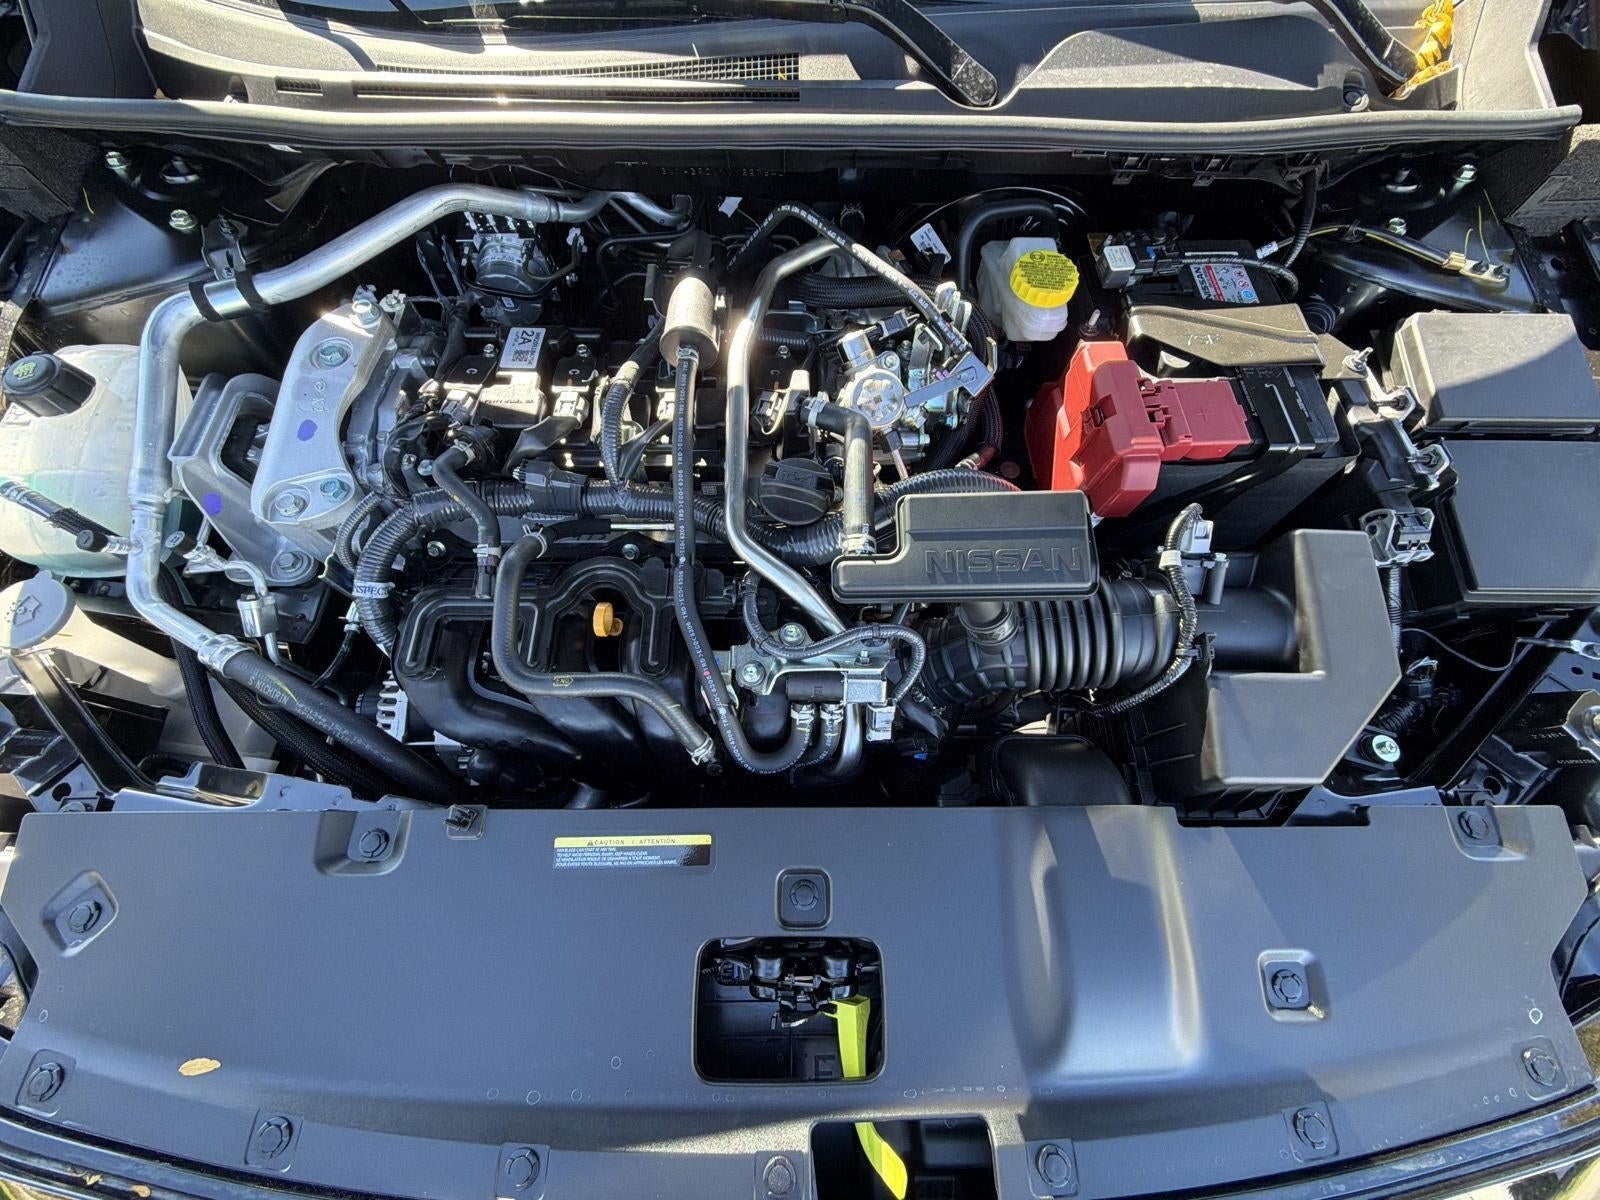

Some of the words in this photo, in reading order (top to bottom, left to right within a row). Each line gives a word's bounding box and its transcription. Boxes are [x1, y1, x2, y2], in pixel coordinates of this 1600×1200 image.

[1193, 266, 1212, 299] NISSAN
[517, 329, 536, 346] 2A
[925, 547, 1082, 574] NISSAN
